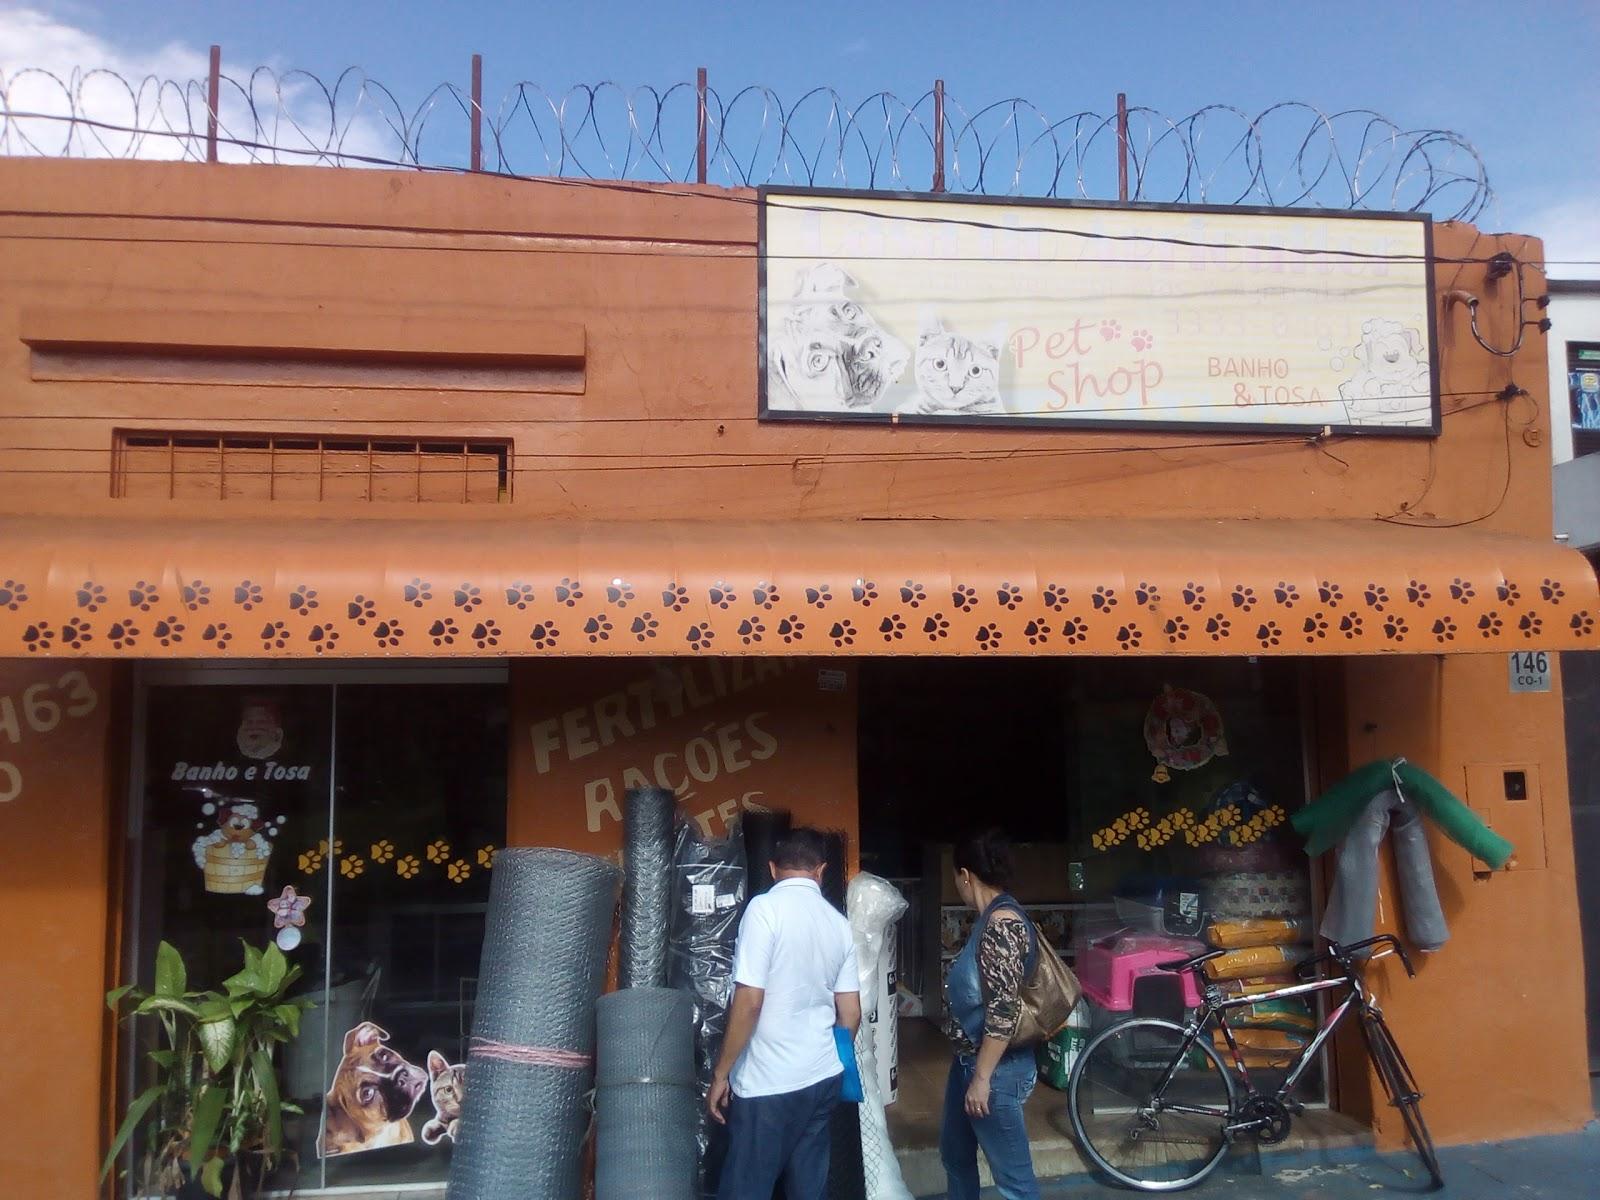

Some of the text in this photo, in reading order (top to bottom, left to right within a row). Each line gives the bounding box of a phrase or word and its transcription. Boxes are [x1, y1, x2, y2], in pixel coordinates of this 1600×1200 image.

[1009, 318, 1097, 368] Pet
[1207, 356, 1289, 379] BANHO
[1233, 382, 1326, 408] & TOSA
[1511, 651, 1548, 673] 146
[1517, 675, 1543, 686] CO-1
[171, 761, 311, 781] Banho e Tosa
